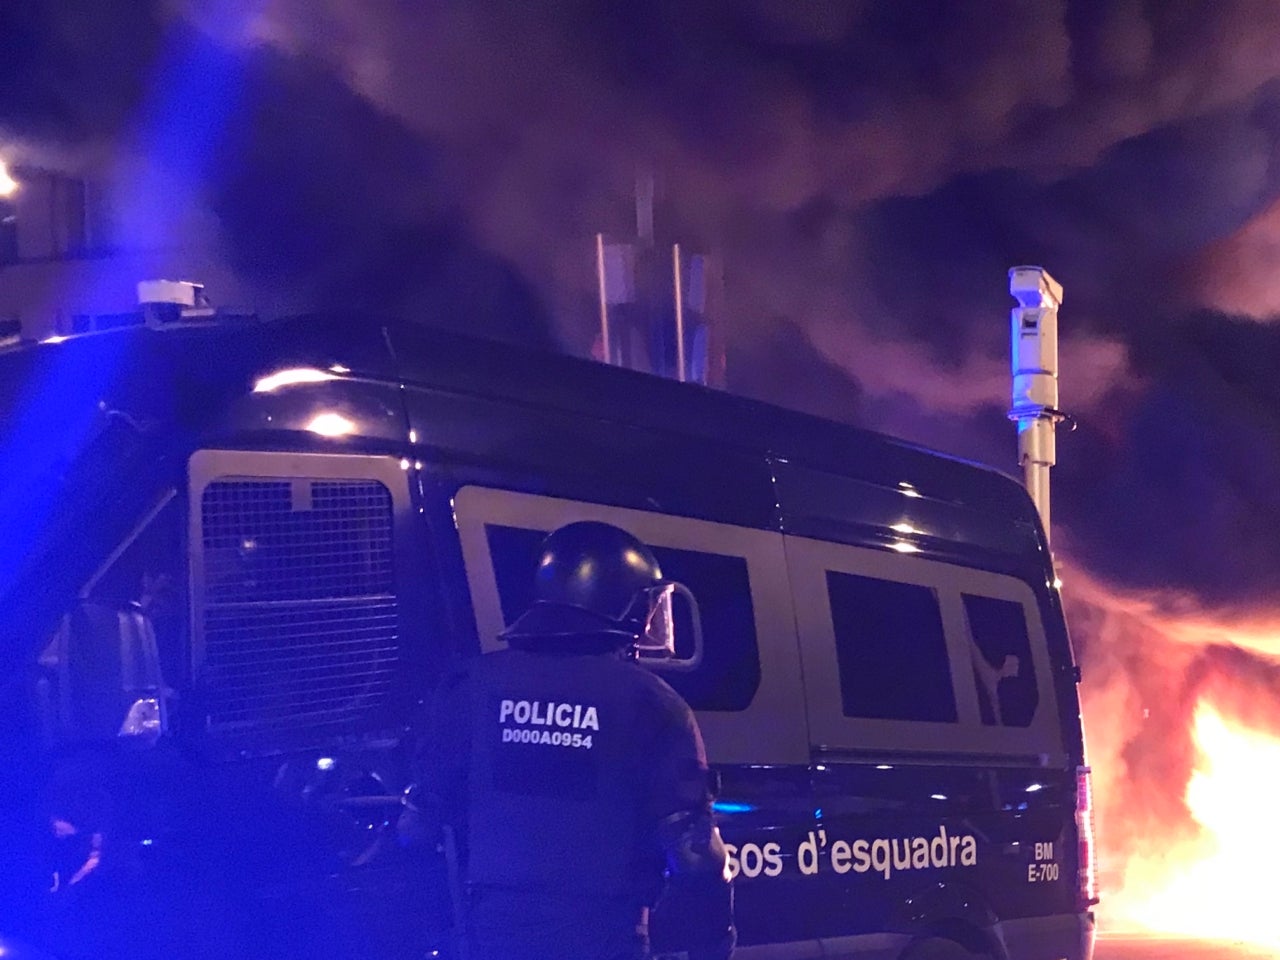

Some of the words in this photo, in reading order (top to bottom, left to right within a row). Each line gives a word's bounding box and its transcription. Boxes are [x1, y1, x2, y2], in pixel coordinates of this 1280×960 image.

[499, 699, 600, 731] POLICIA
[797, 824, 978, 881] d'esquadra
[1034, 841, 1054, 861] BM
[1028, 862, 1060, 882] E-700
